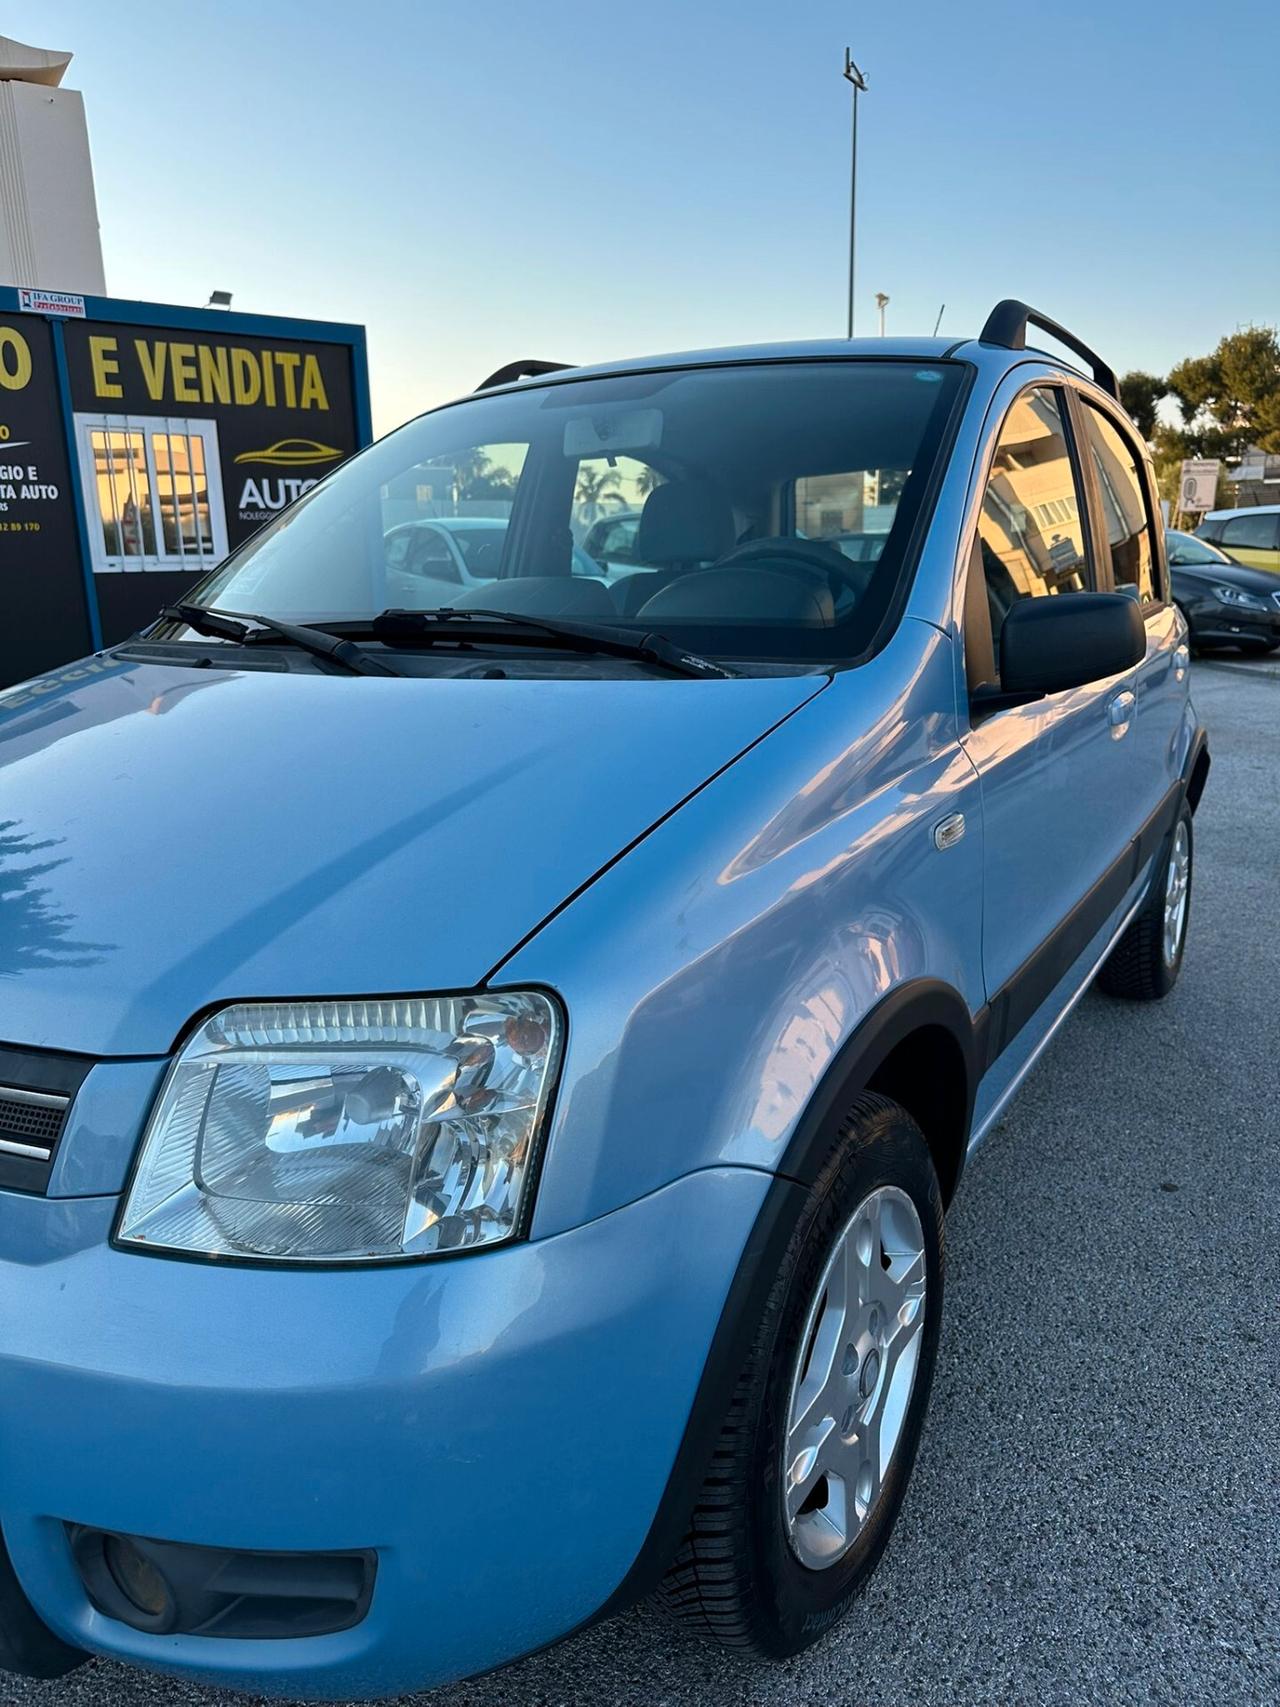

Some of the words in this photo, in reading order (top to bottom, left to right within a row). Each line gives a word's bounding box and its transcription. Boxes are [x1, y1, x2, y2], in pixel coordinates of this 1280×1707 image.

[32, 292, 48, 301] IFA
[50, 294, 83, 305] GROUP
[89, 335, 123, 398] E
[134, 339, 329, 410] VENDITA
[27, 466, 38, 481] E
[20, 484, 59, 500] AUTO
